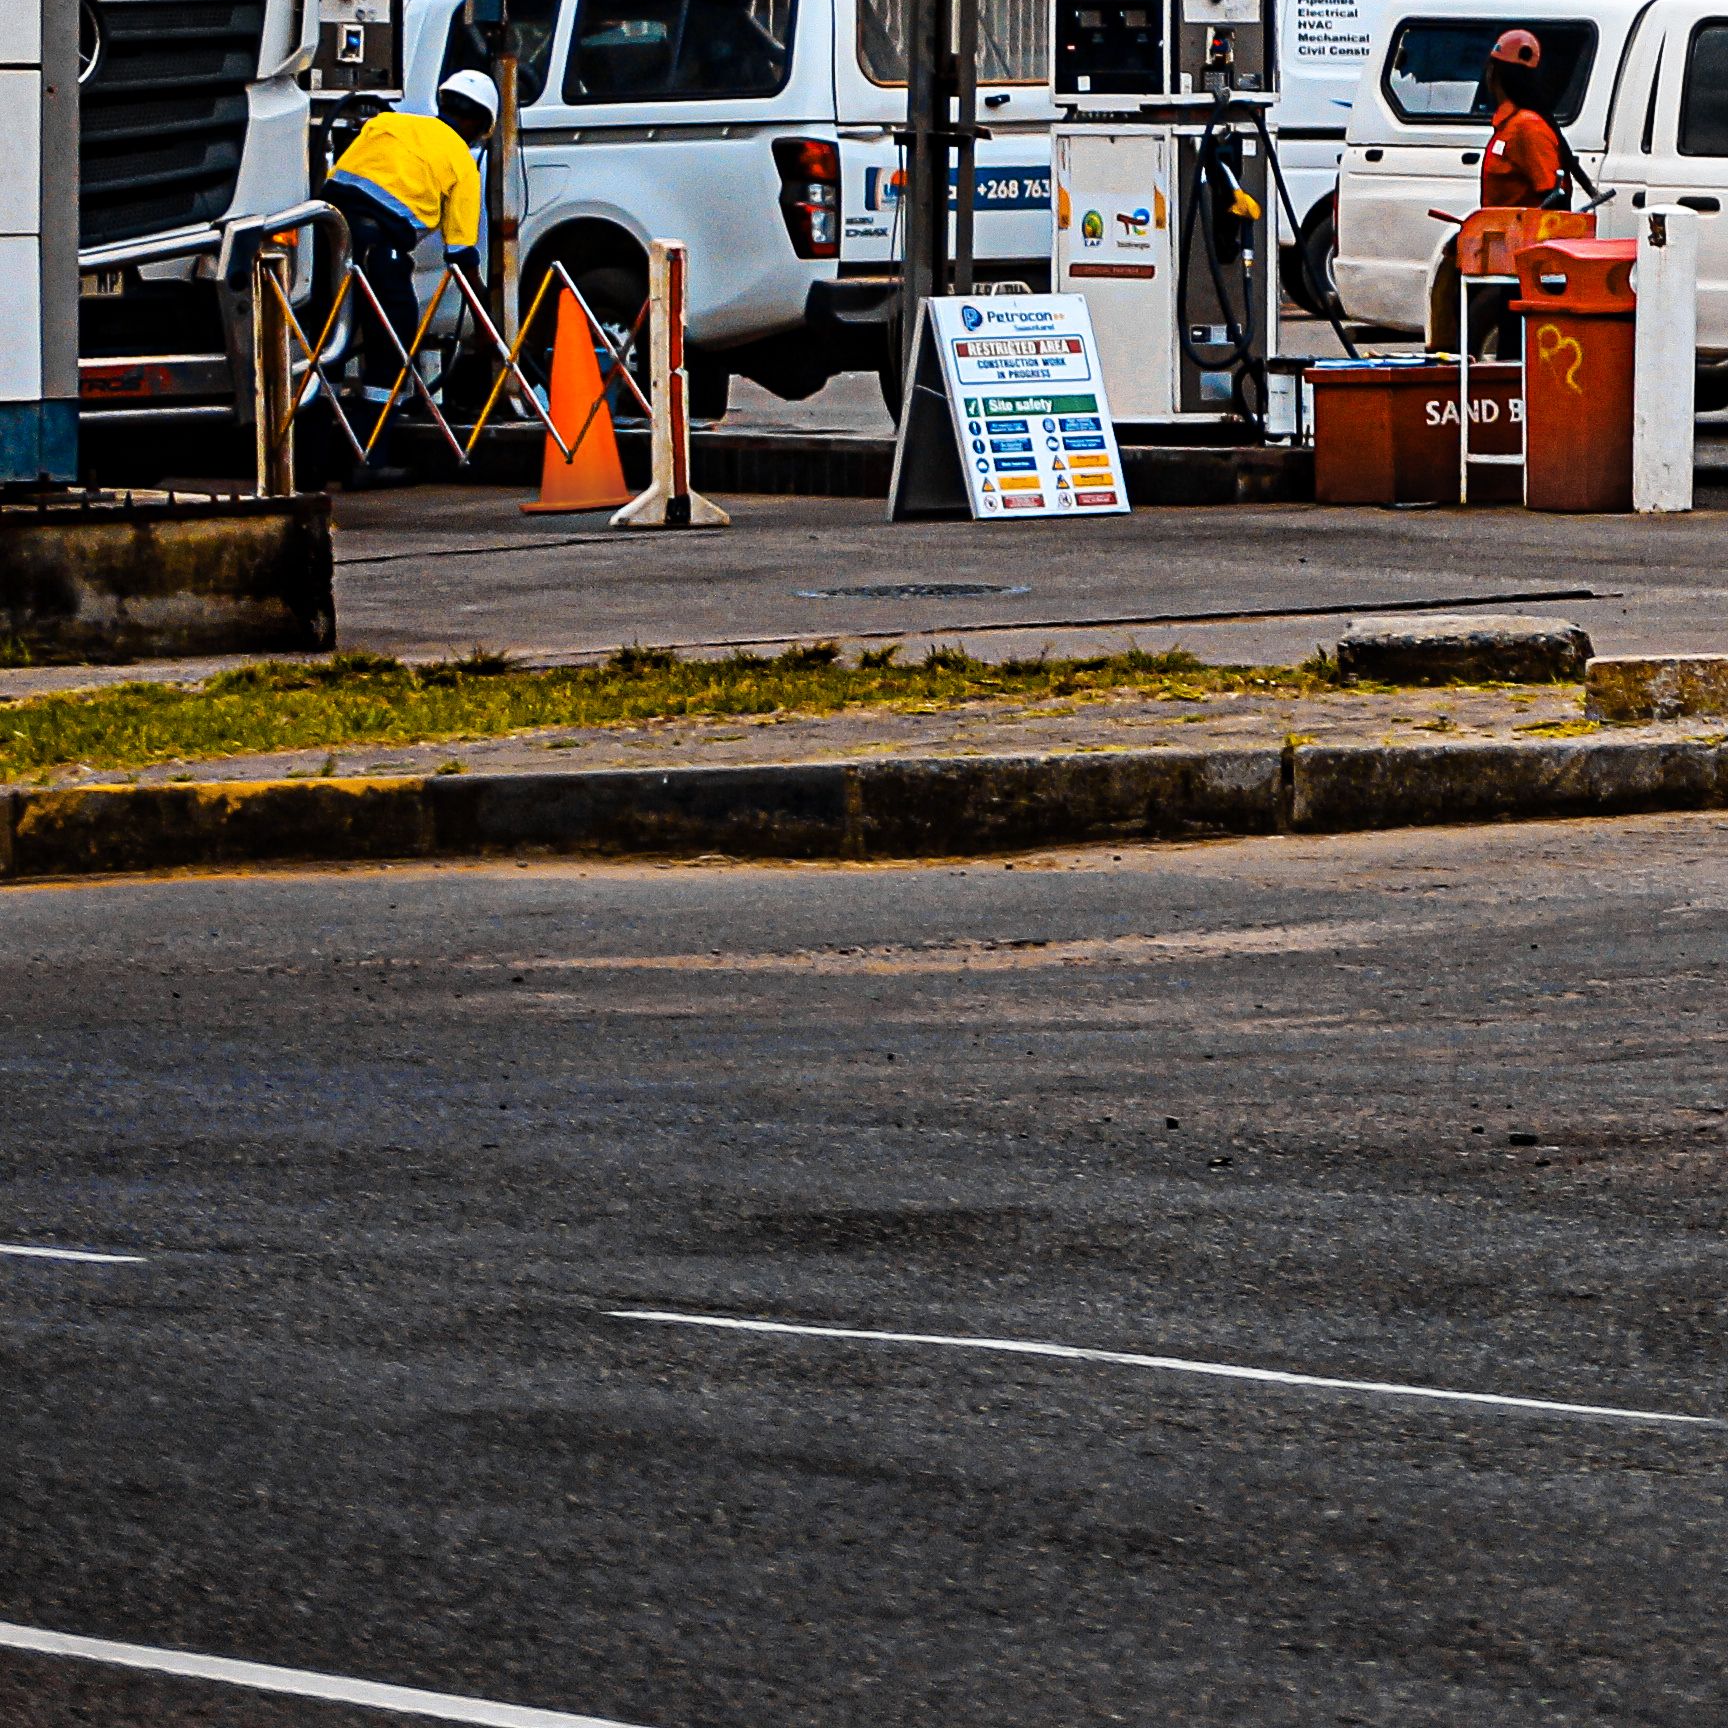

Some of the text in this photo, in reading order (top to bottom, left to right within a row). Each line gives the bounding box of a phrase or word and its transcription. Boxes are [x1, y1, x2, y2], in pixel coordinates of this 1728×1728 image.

[1298, 8, 1358, 18] Electrical
[1298, 20, 1332, 29] HVAC
[1298, 33, 1370, 43] Mechanical
[1298, 46, 1325, 56] Civil
[977, 179, 1018, 199] +268
[987, 310, 1052, 323] Petrocon
[967, 339, 1070, 356] RESTRICTED AREA
[977, 357, 1067, 369] CONSTRUCTION WORK
[997, 369, 1051, 379] IN PROGRESS
[988, 397, 1054, 412] Site safety
[1425, 399, 1499, 426] SAND
